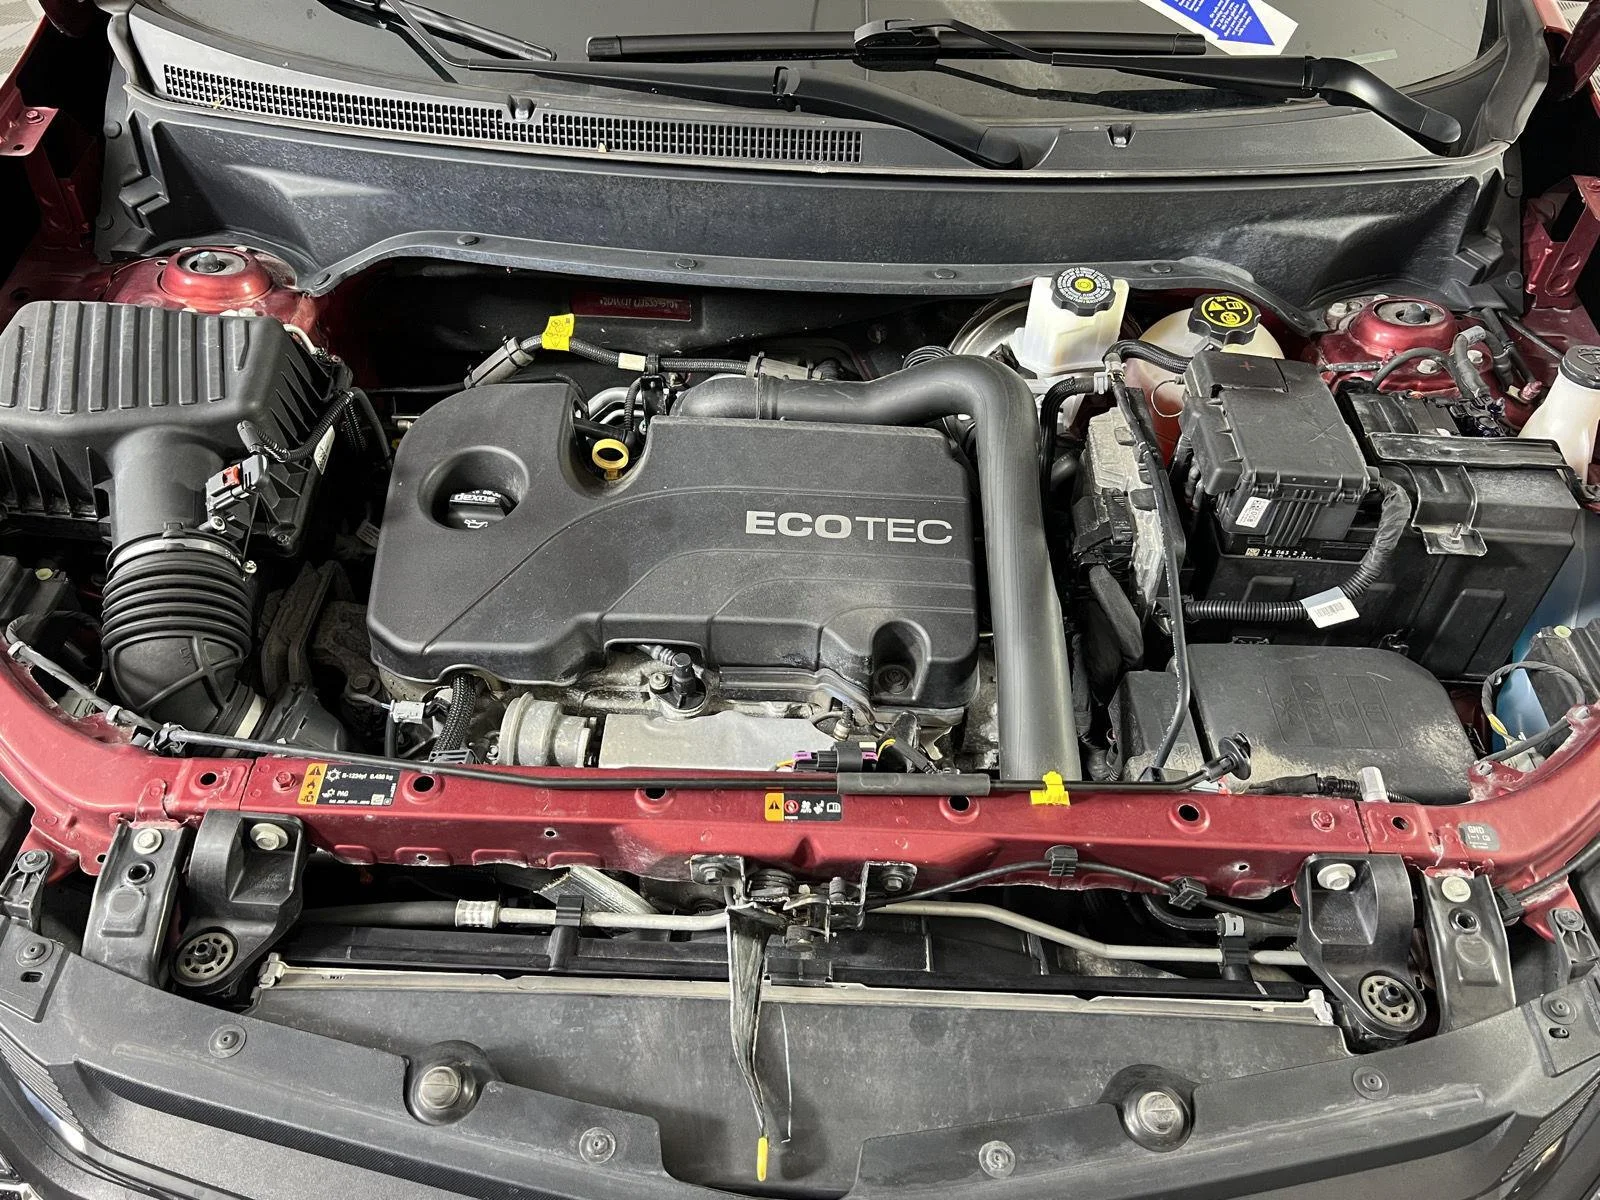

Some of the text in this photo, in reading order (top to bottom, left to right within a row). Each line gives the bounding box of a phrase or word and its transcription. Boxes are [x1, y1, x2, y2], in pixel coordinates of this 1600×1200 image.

[454, 493, 497, 502] dexos
[745, 510, 953, 545] ECOTEC
[1467, 825, 1485, 835] GND
